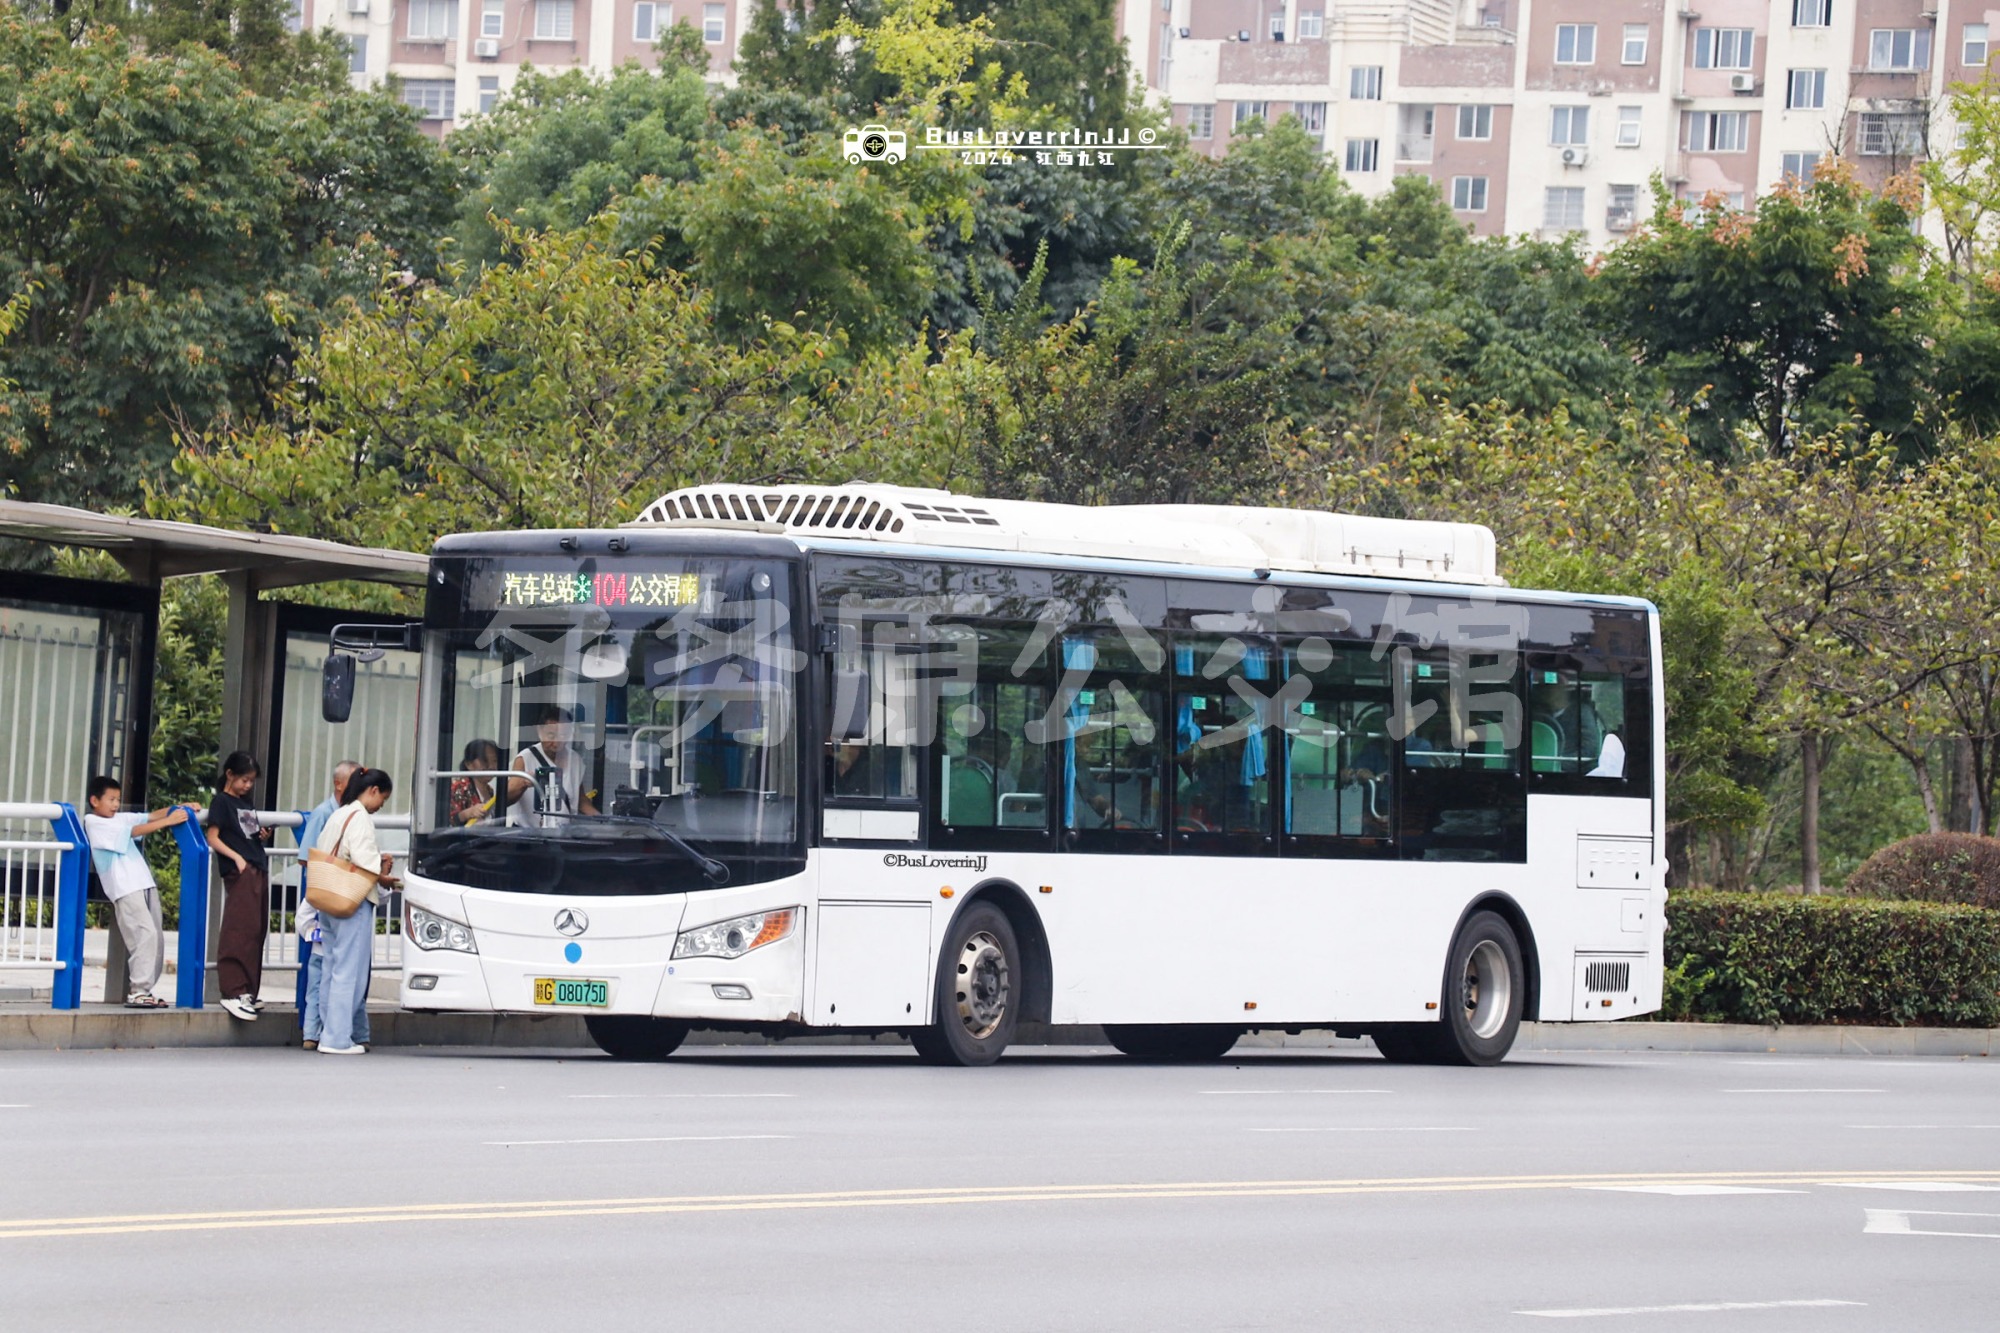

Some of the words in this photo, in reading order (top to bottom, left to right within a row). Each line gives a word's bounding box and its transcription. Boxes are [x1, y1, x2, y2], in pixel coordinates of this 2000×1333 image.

[504, 573, 575, 605] 汽车总站
[593, 573, 627, 606] 104
